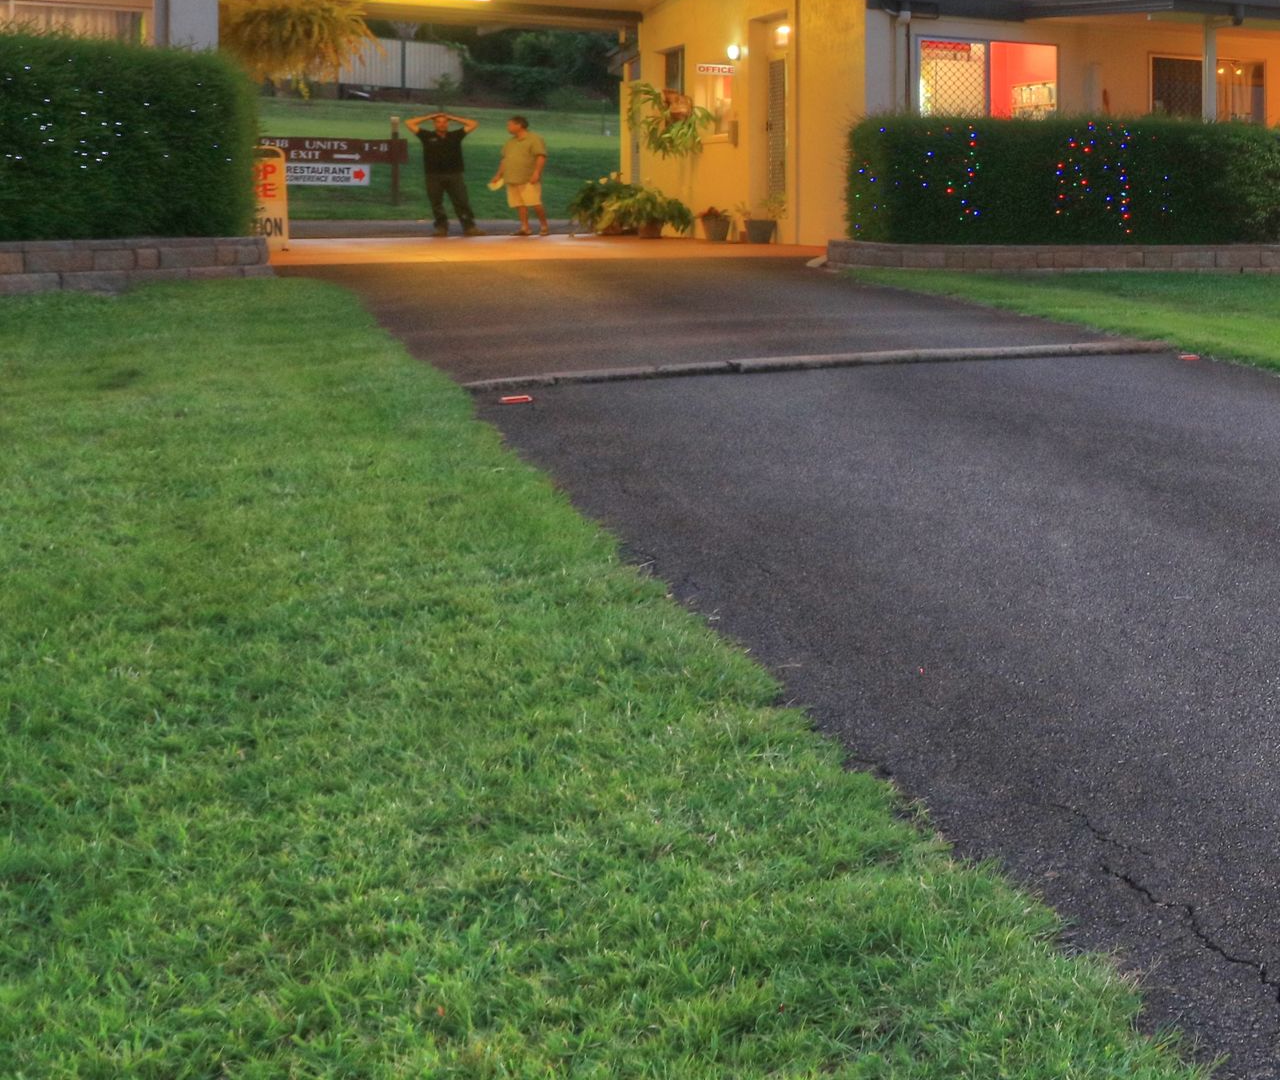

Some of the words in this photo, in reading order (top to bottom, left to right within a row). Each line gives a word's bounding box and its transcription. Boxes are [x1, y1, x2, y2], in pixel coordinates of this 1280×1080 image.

[698, 65, 734, 74] OFFICE
[304, 140, 348, 150] UNITS
[289, 150, 321, 160] EXIT
[286, 165, 351, 175] RESTAURANT
